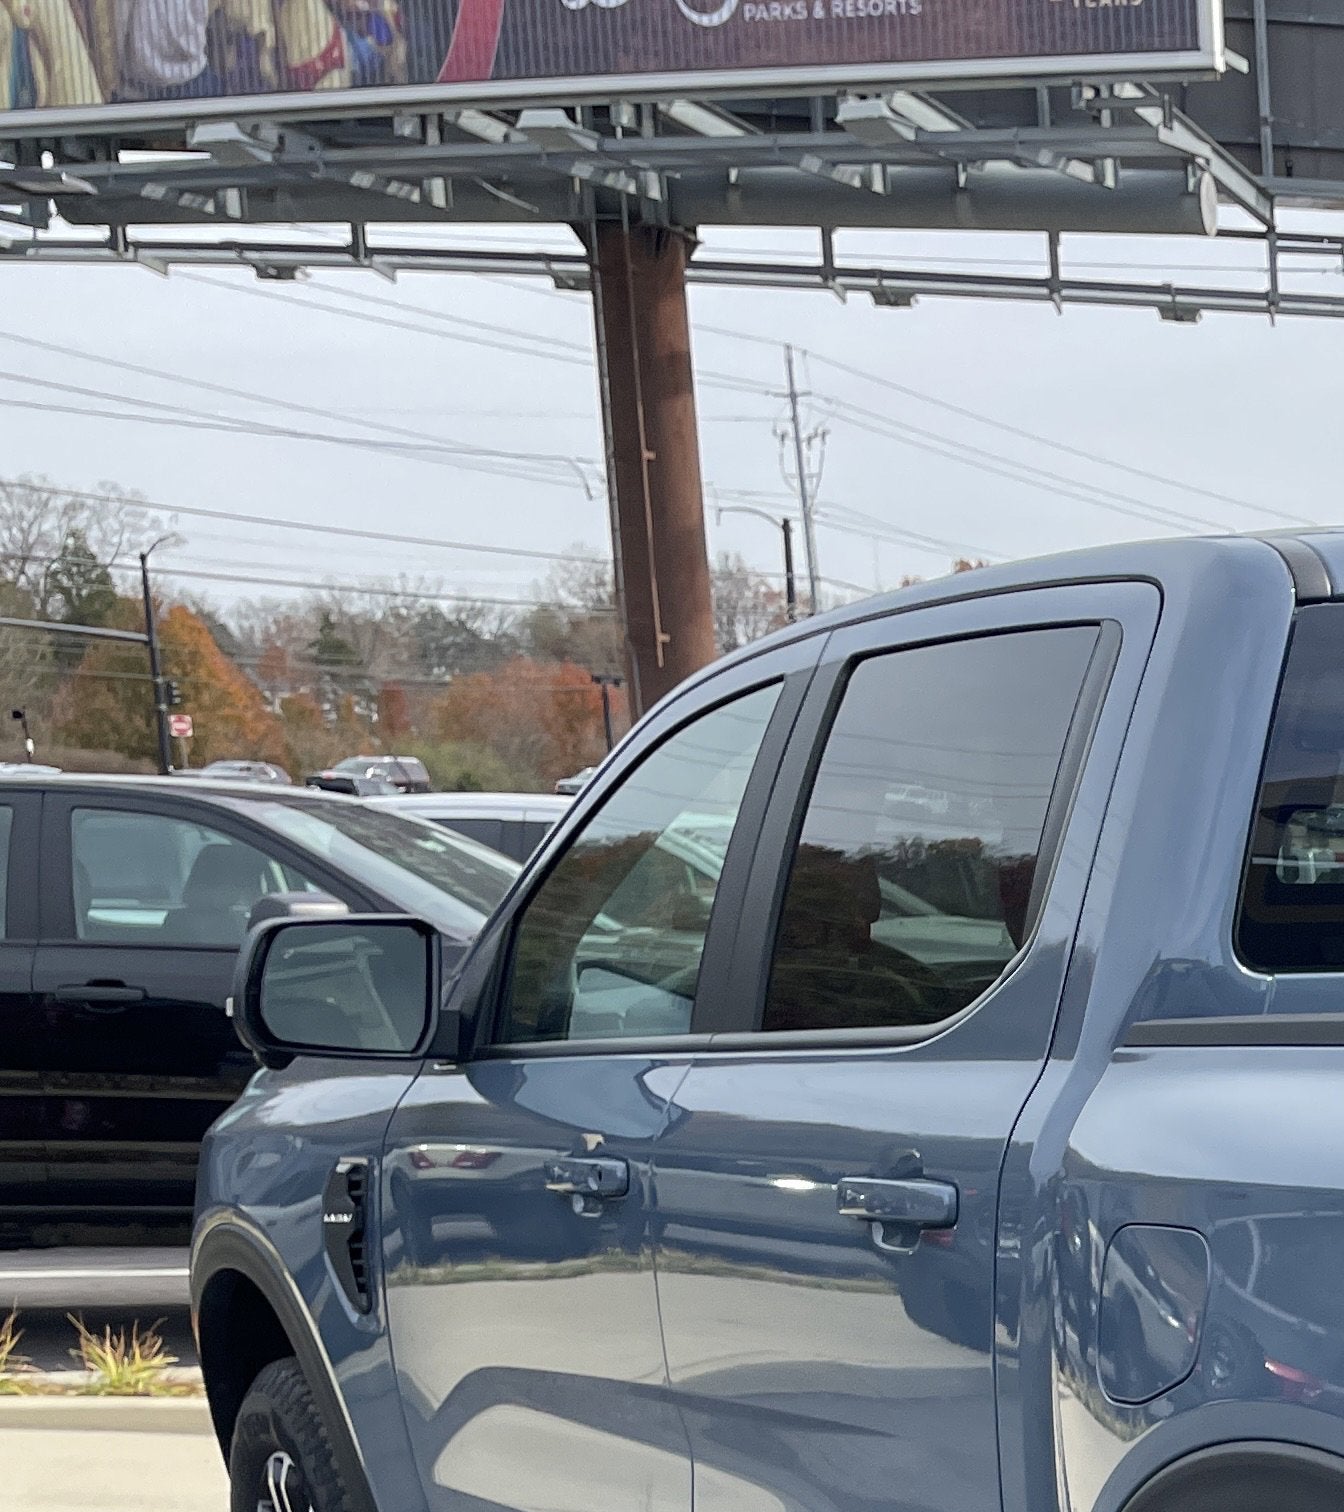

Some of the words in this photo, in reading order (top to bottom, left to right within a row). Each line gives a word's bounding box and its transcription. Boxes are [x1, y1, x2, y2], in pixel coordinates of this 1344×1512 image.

[743, 2, 808, 22] PARKS
[812, 0, 825, 19] &
[831, 0, 922, 17] RESORTS
